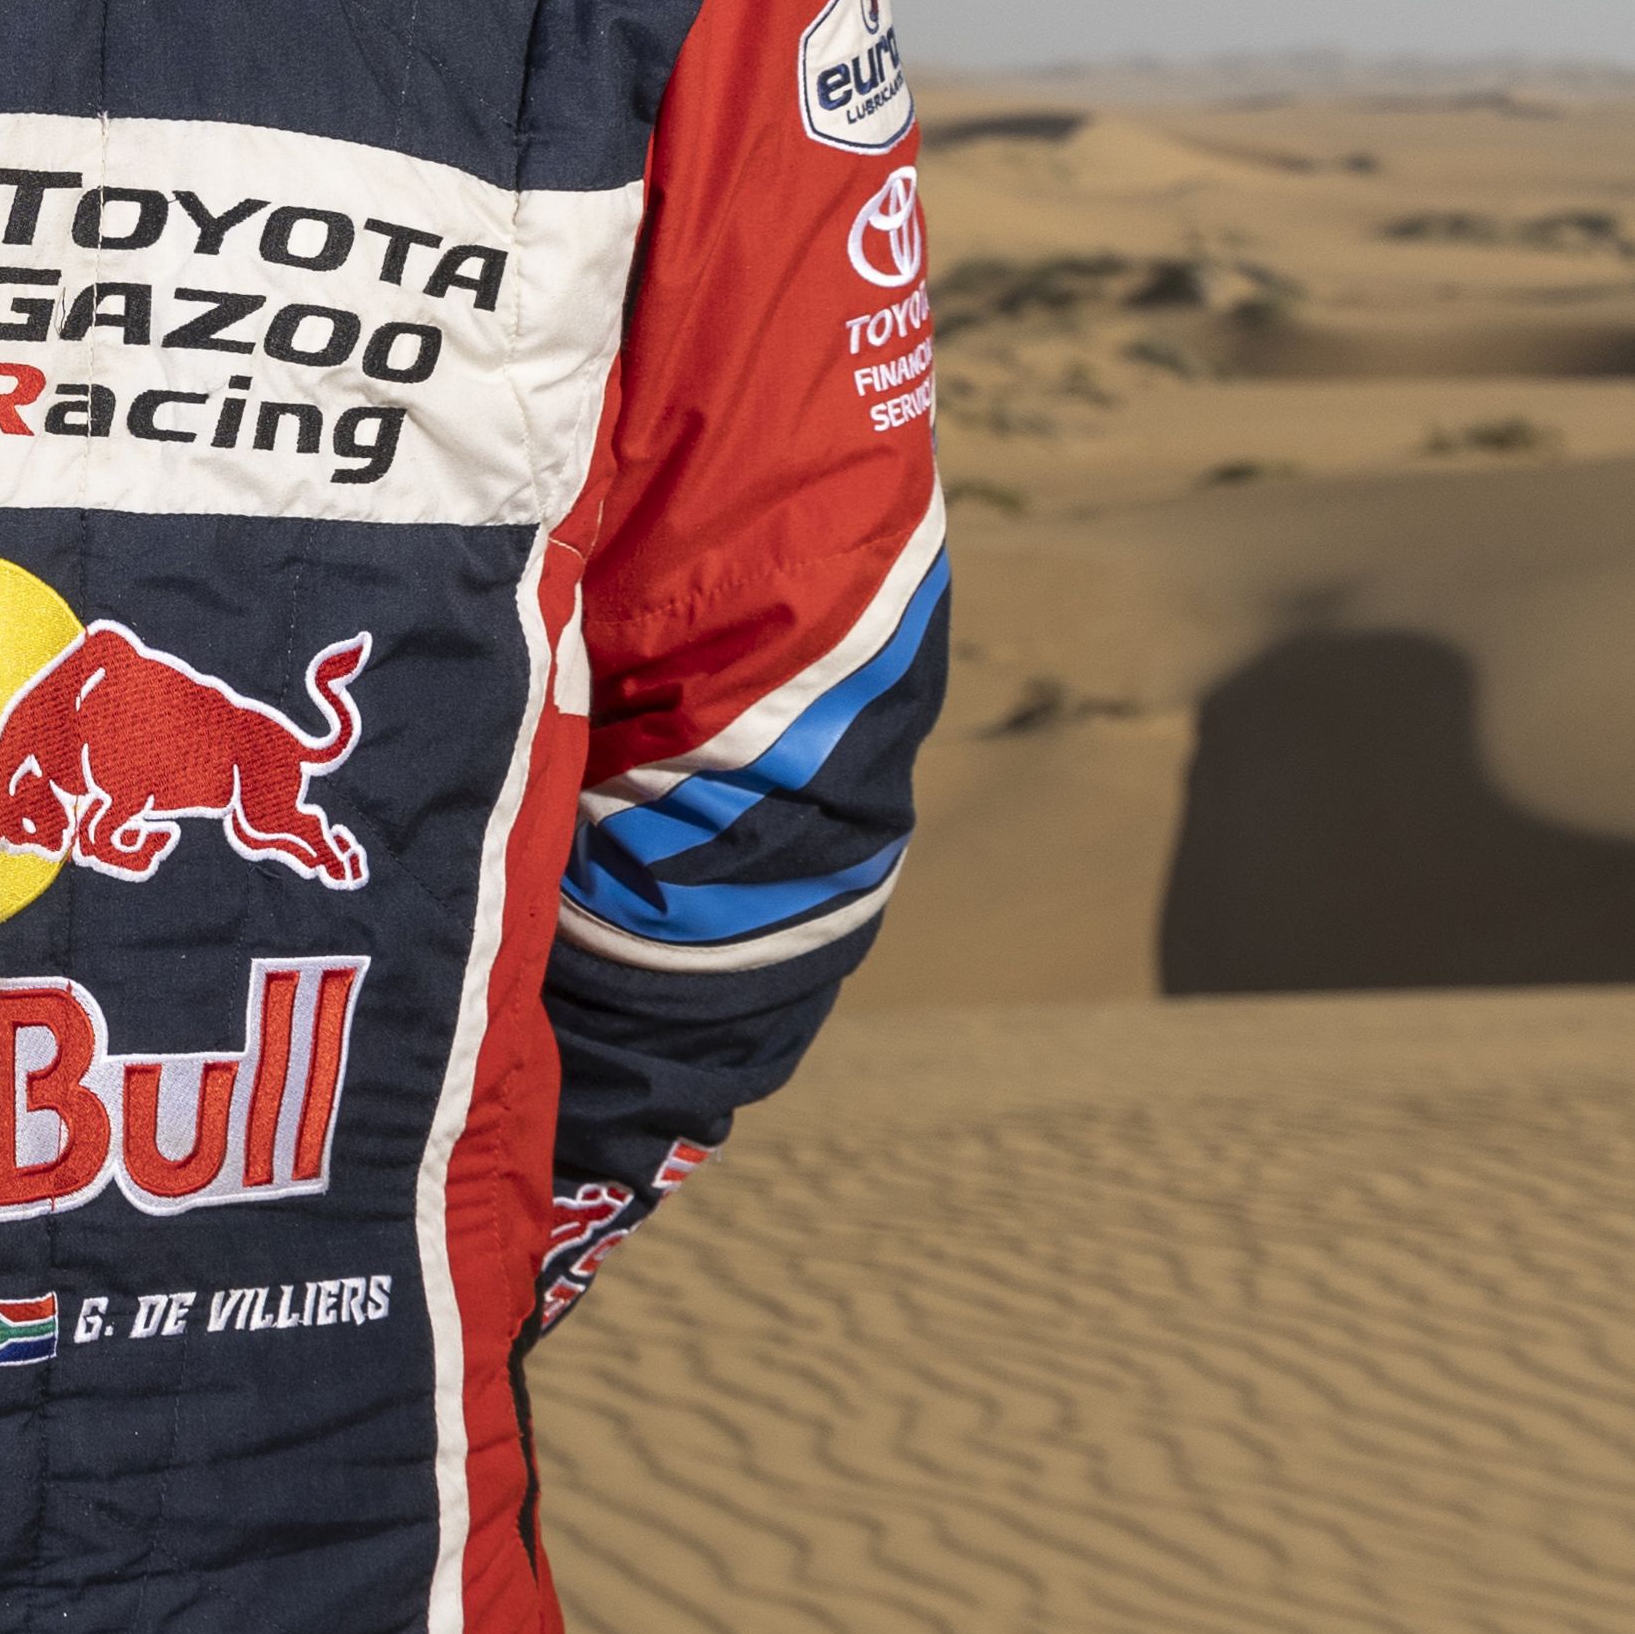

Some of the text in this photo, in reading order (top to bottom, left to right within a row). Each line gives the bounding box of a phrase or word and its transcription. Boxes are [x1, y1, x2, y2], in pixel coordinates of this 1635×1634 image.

[817, 25, 900, 111] euro
[73, 1275, 393, 1344] G. DE VILLIERS
